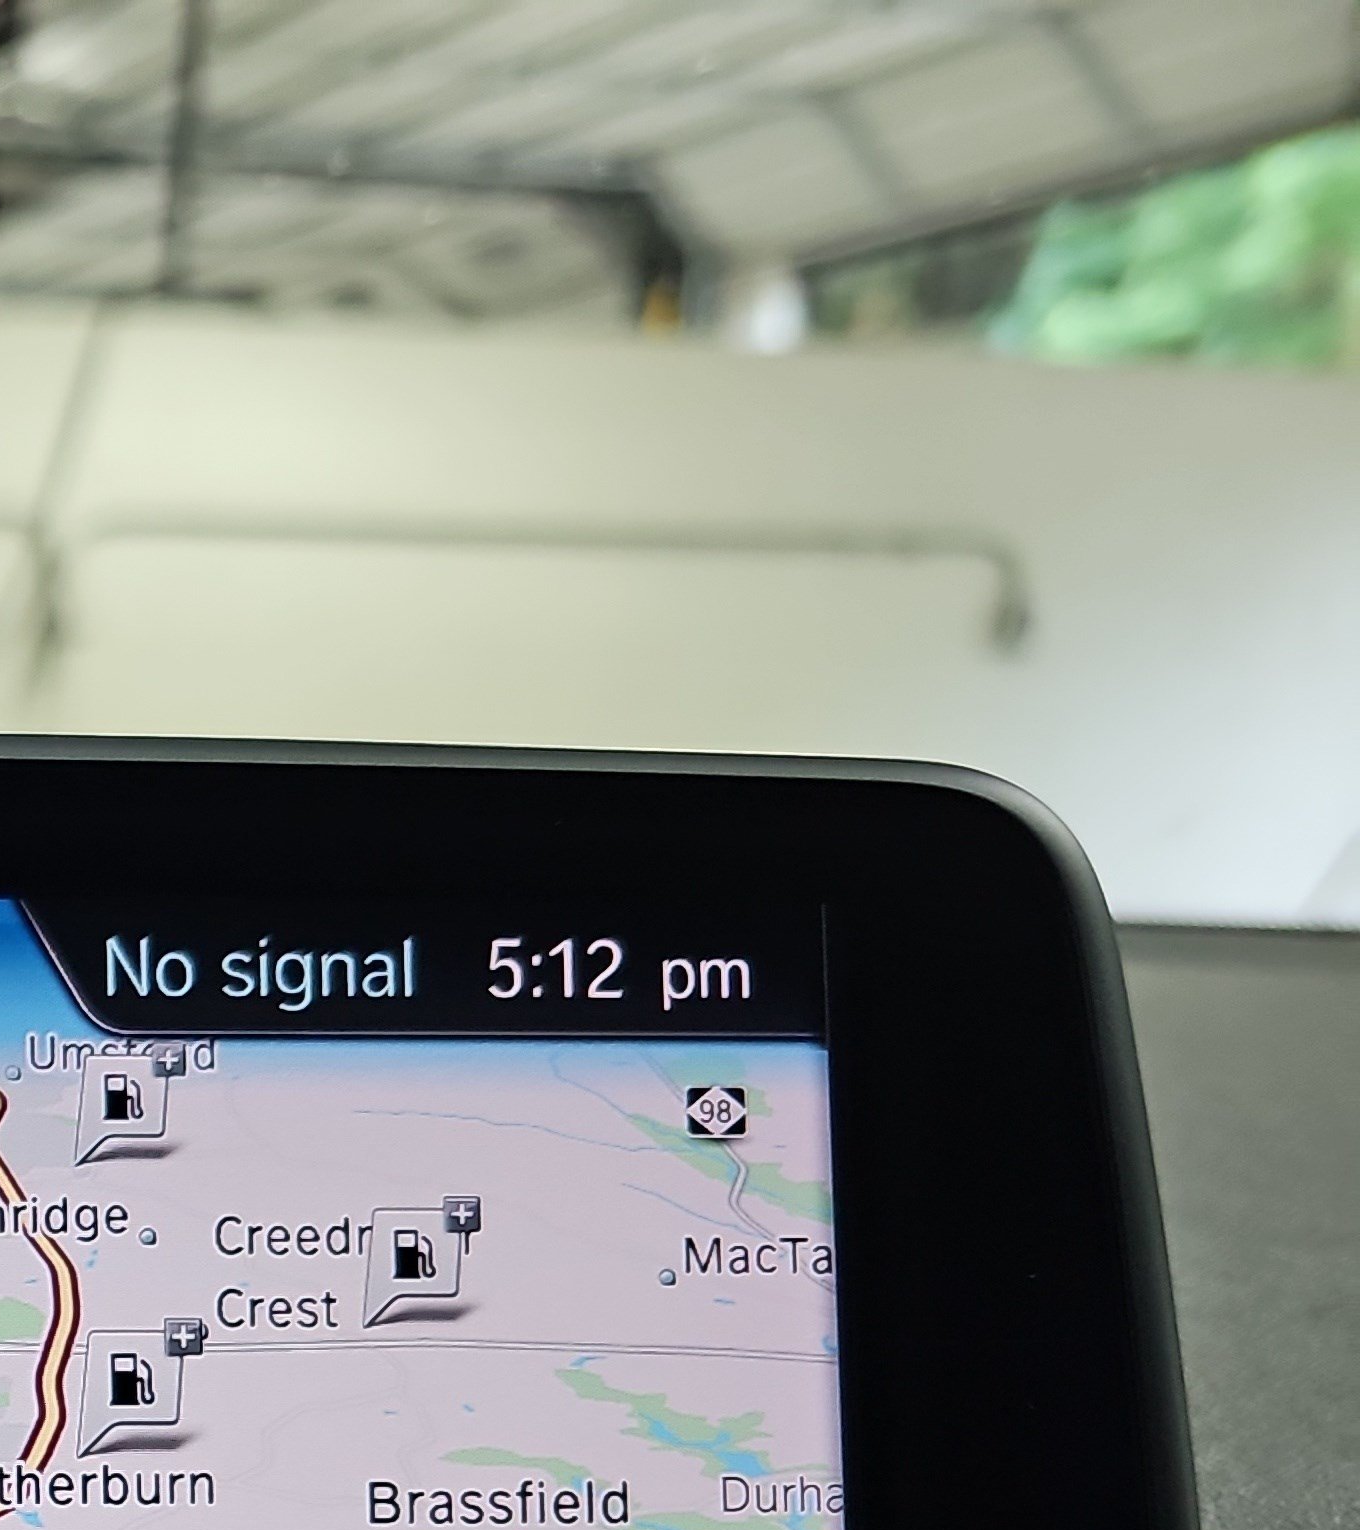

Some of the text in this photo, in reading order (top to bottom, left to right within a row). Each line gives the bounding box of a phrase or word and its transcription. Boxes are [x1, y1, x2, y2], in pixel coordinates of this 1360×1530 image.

[105, 936, 416, 1011] No signal
[488, 938, 752, 1010] 5:12 pm
[698, 1100, 733, 1125] 98
[216, 1289, 337, 1328] Crest
[369, 1481, 629, 1525] Brassfield
